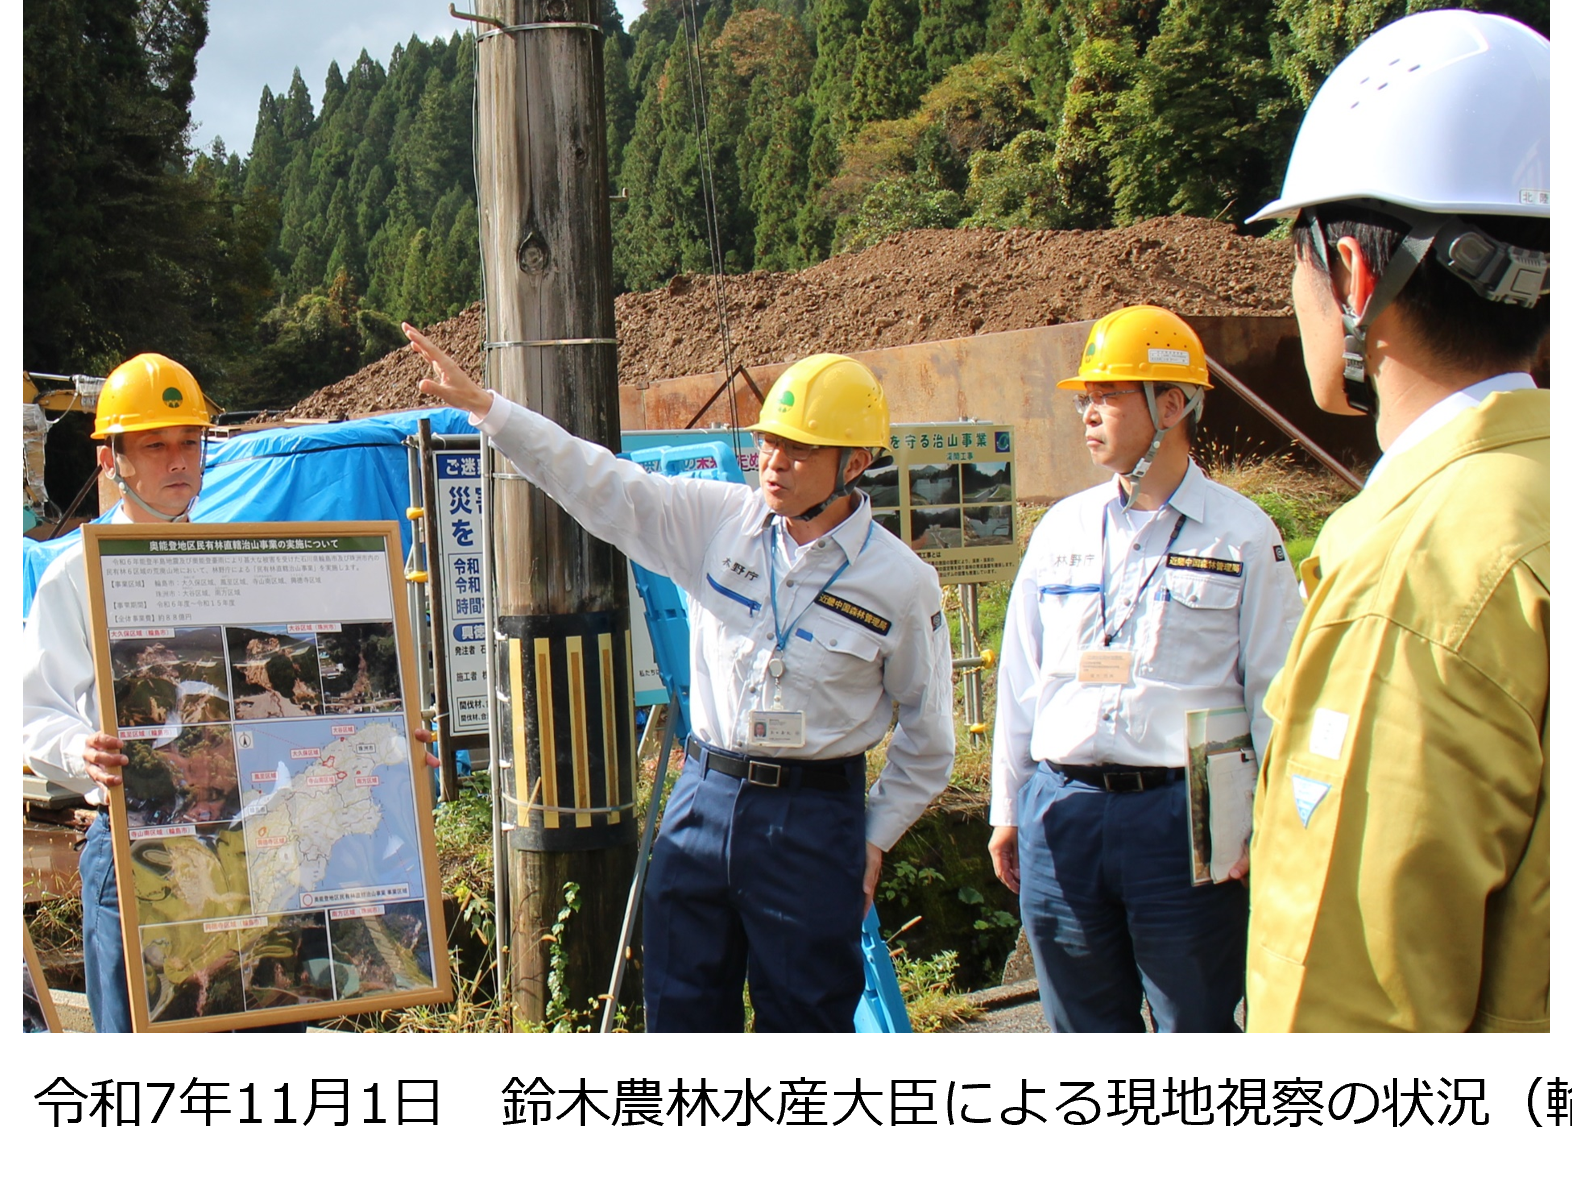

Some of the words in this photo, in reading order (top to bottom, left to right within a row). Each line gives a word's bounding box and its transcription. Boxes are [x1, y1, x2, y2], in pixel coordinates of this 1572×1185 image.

[890, 433, 987, 449] を守る治山事業
[446, 457, 481, 476] ご迷
[451, 519, 474, 546] を
[149, 539, 339, 552] 奥能登地区民有林直轄治山事業の実施について
[453, 558, 479, 575] 令和
[1054, 553, 1095, 567] 林野庁
[455, 576, 480, 594] 令和
[456, 597, 485, 615] 時間
[455, 645, 475, 656] 発注者
[456, 671, 477, 682] 施工者
[459, 700, 488, 710] 間伐材、
[460, 713, 489, 722] 間伐材、合
